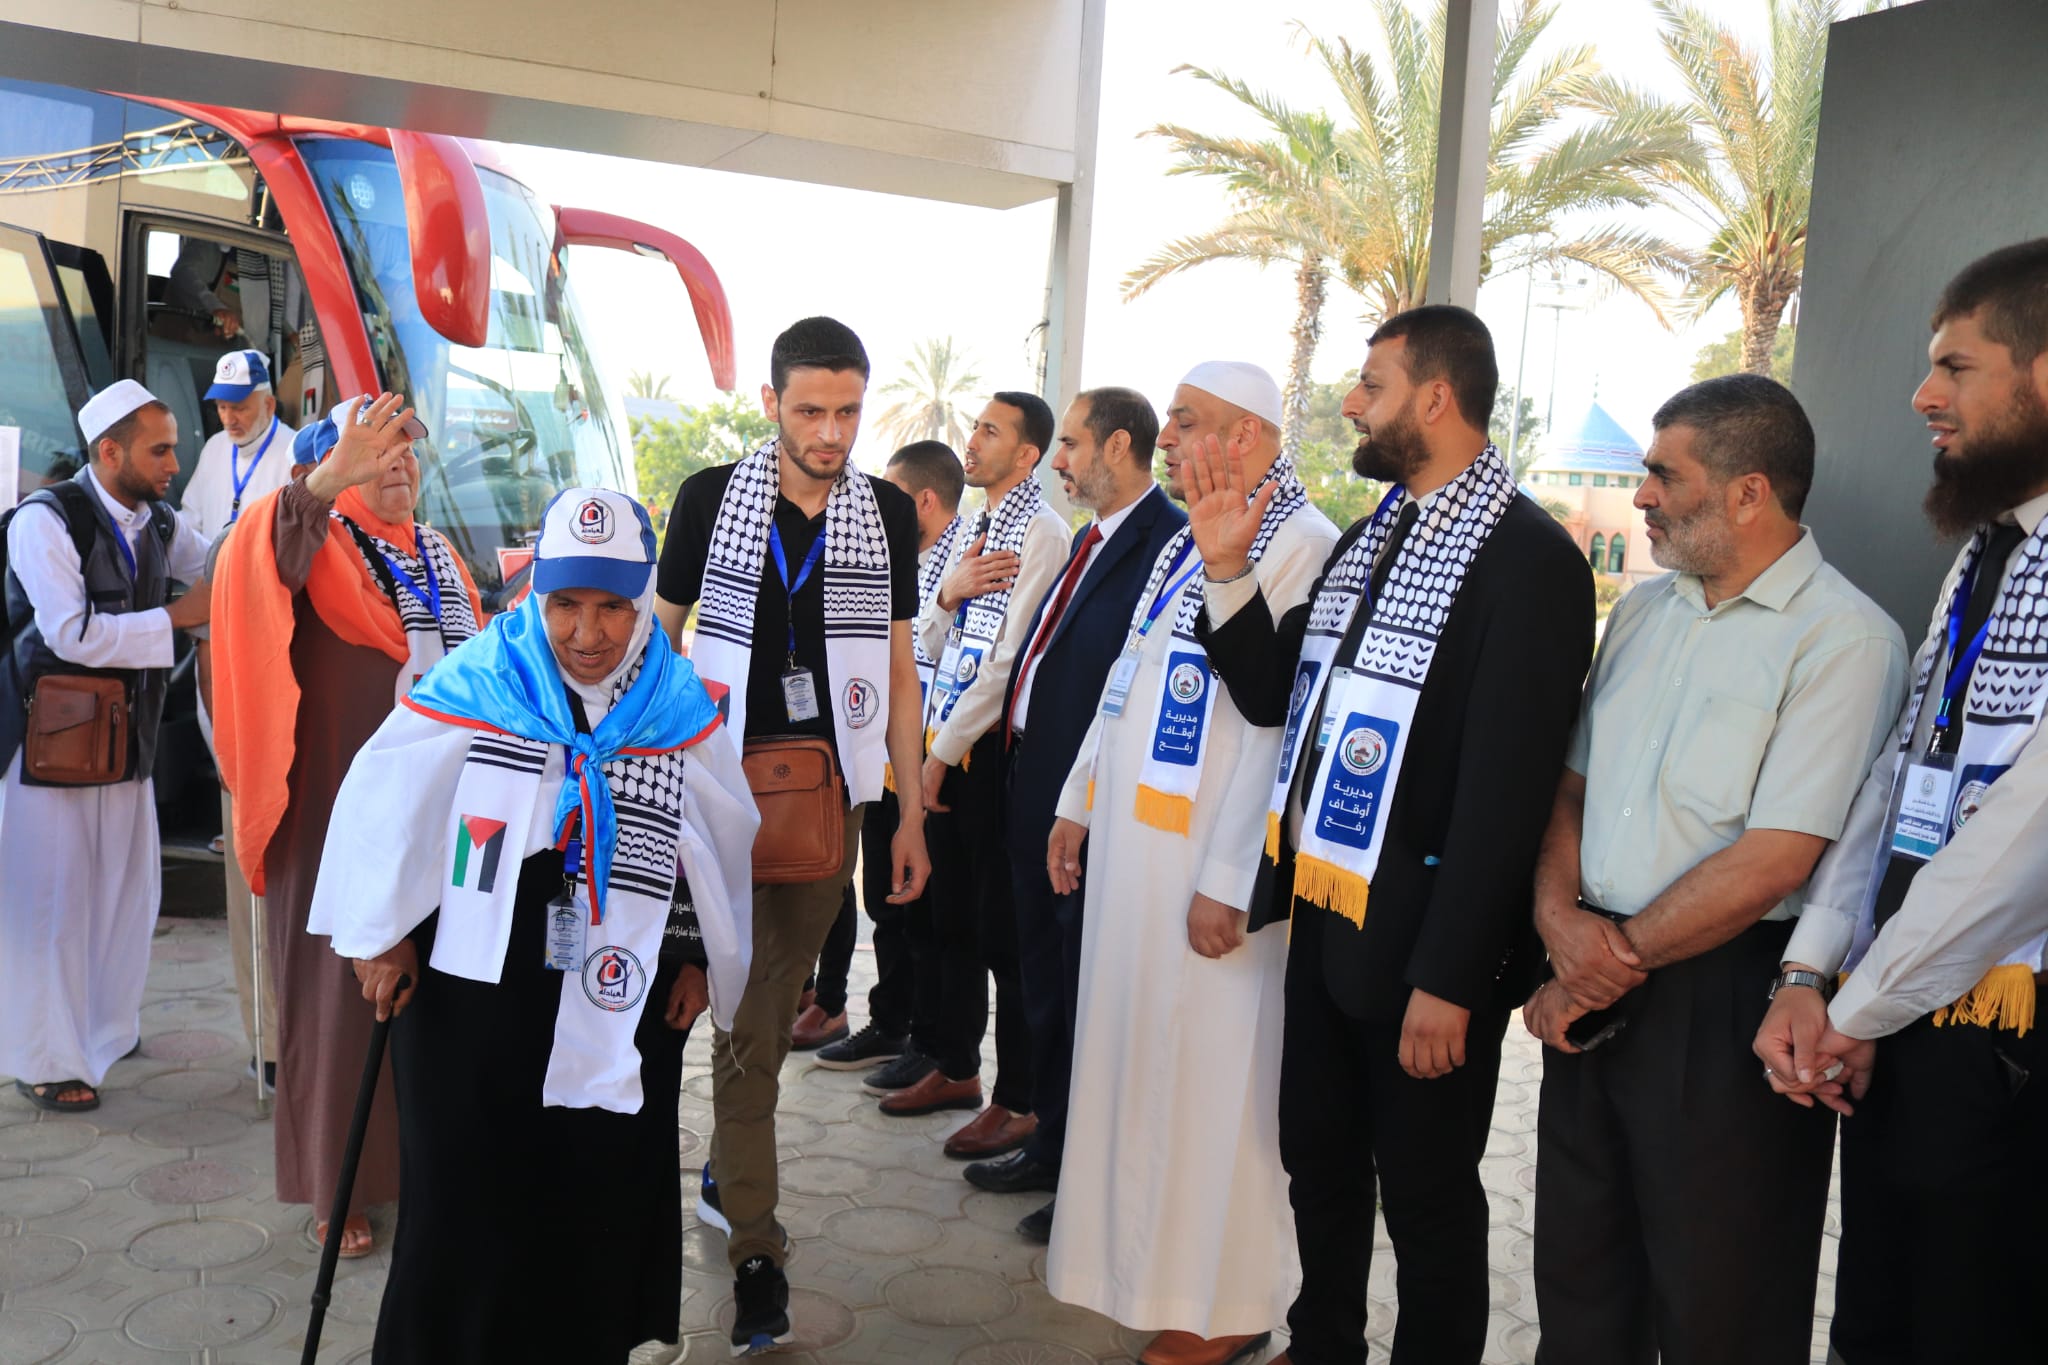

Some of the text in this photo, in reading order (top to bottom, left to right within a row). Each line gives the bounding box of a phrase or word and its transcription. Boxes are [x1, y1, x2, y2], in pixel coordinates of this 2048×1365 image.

[1165, 709, 1198, 724] مديرية
[1162, 725, 1197, 740] أوقاف
[1158, 741, 1193, 754] رفح
[1333, 779, 1373, 799] مديرية
[1328, 798, 1372, 819] أوقاف
[1323, 815, 1366, 836] رفح
